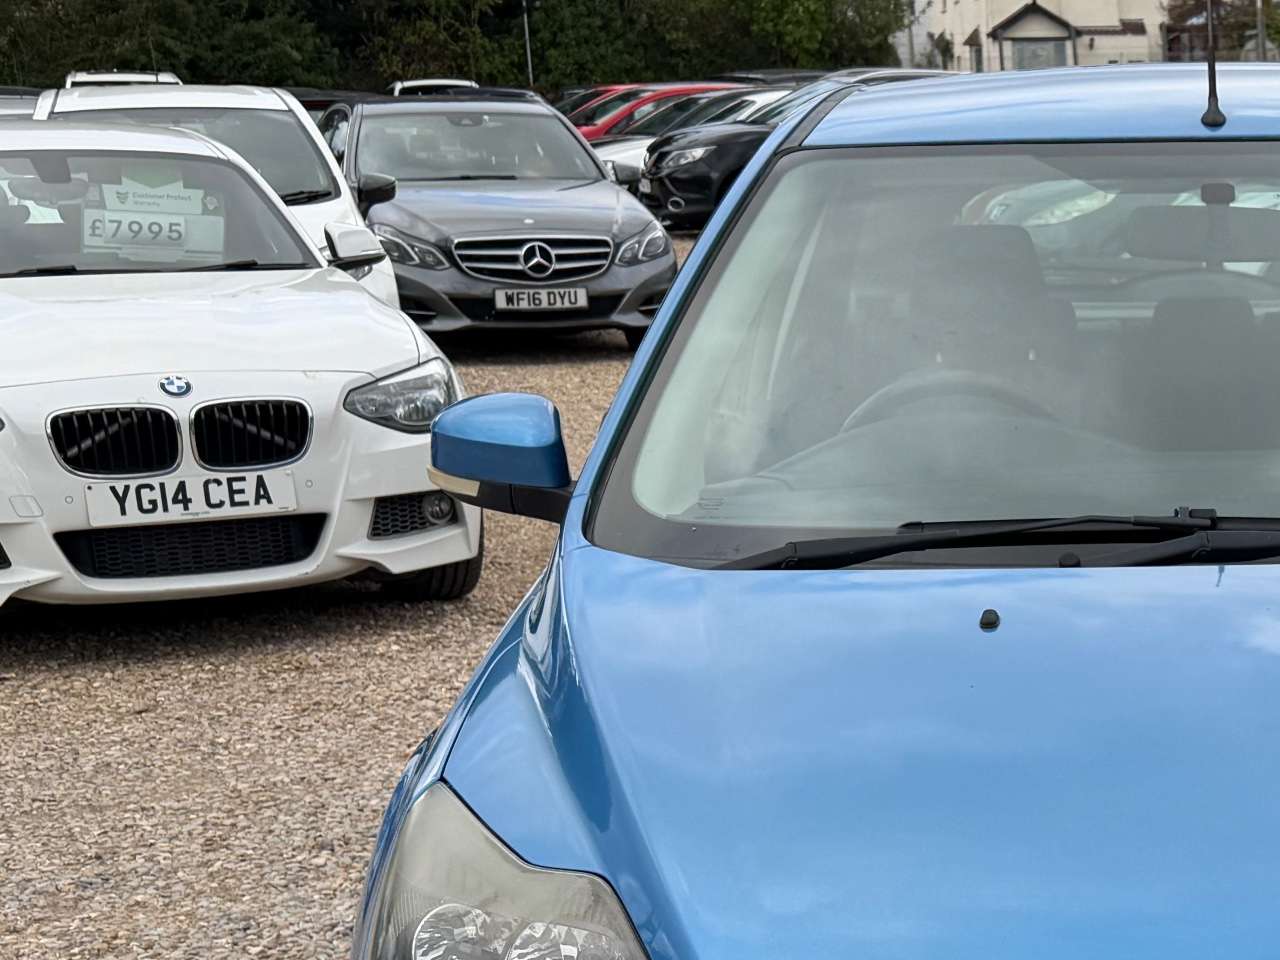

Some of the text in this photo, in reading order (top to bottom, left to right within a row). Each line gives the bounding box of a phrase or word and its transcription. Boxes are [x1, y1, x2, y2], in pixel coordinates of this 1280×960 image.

[89, 218, 183, 241] £7995
[504, 290, 578, 307] WF16 DYU
[109, 474, 273, 516] YG14 CEA
